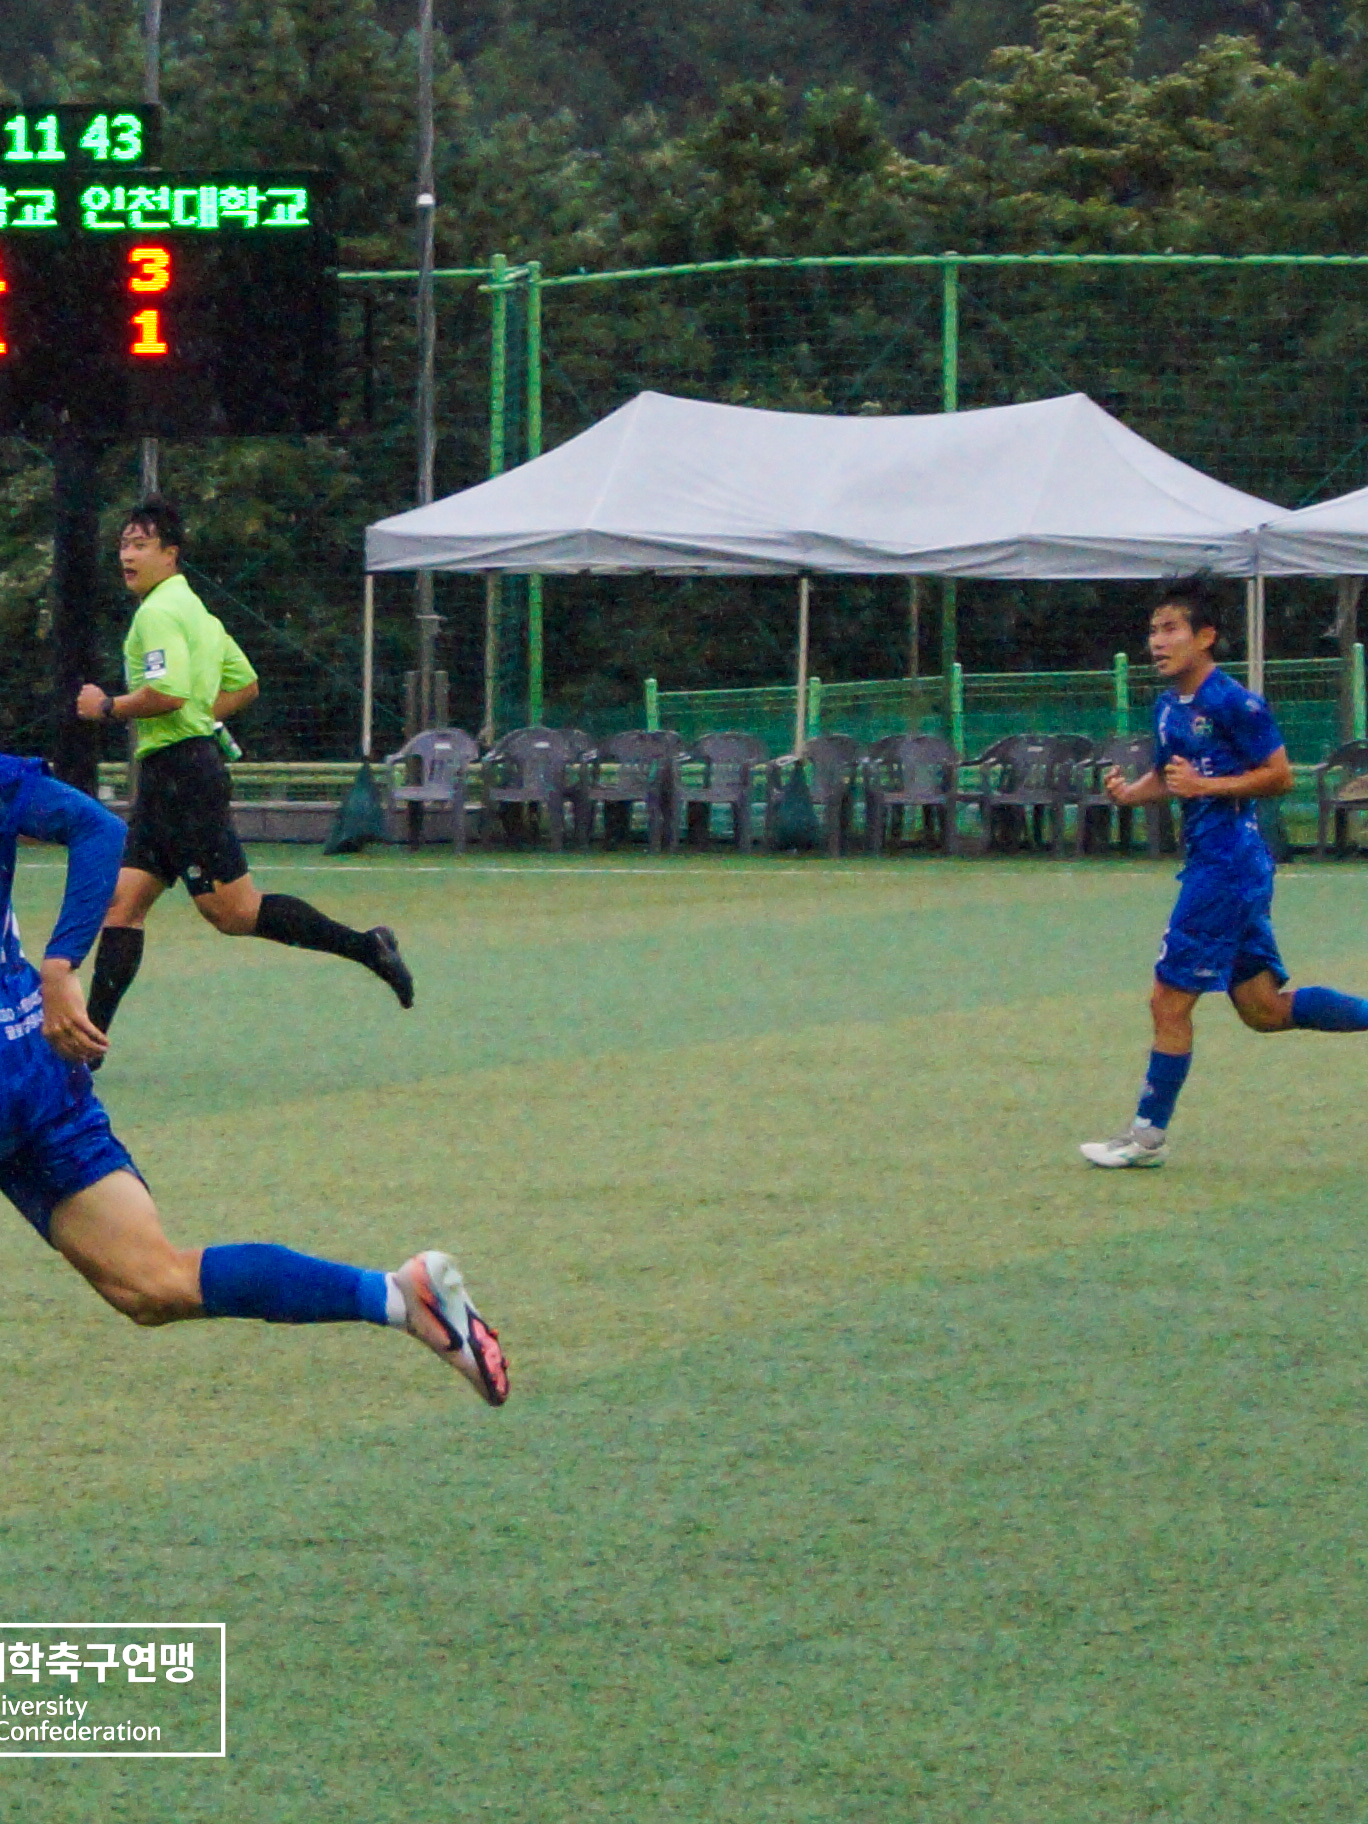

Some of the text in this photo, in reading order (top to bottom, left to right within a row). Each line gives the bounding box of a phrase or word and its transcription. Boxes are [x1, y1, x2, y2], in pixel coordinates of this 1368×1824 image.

[3, 113, 143, 162] 11 43
[79, 185, 311, 231] 인천대학교
[128, 245, 172, 294] 3
[130, 308, 169, 356] 1
